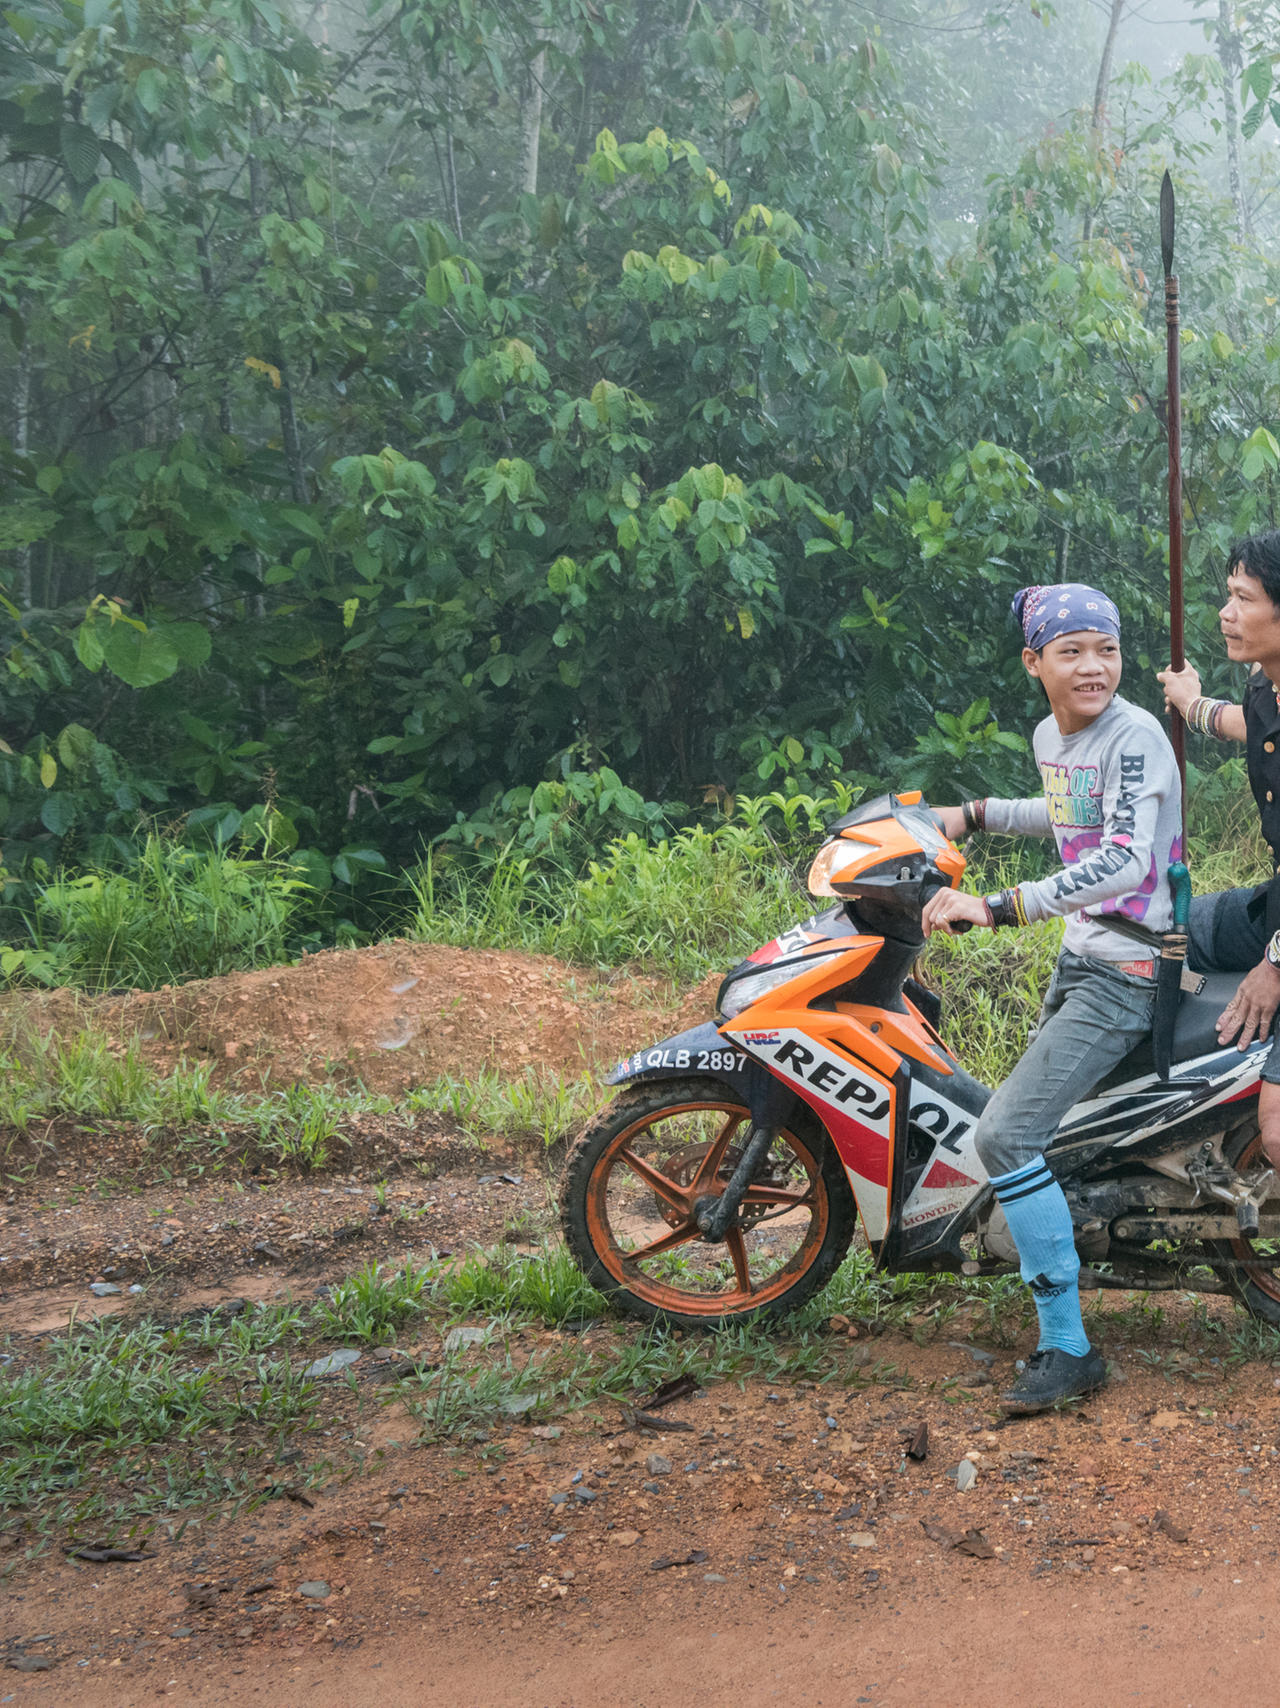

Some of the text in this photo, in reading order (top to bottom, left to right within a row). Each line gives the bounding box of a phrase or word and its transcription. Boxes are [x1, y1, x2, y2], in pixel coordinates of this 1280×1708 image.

[1071, 767, 1098, 796] OF
[1111, 754, 1145, 839] BLACK
[1053, 848, 1132, 899] UNNY
[743, 1031, 781, 1046] HRC
[646, 1050, 691, 1069] QLB
[697, 1051, 748, 1072] 2897
[903, 1202, 959, 1227] HONDA
